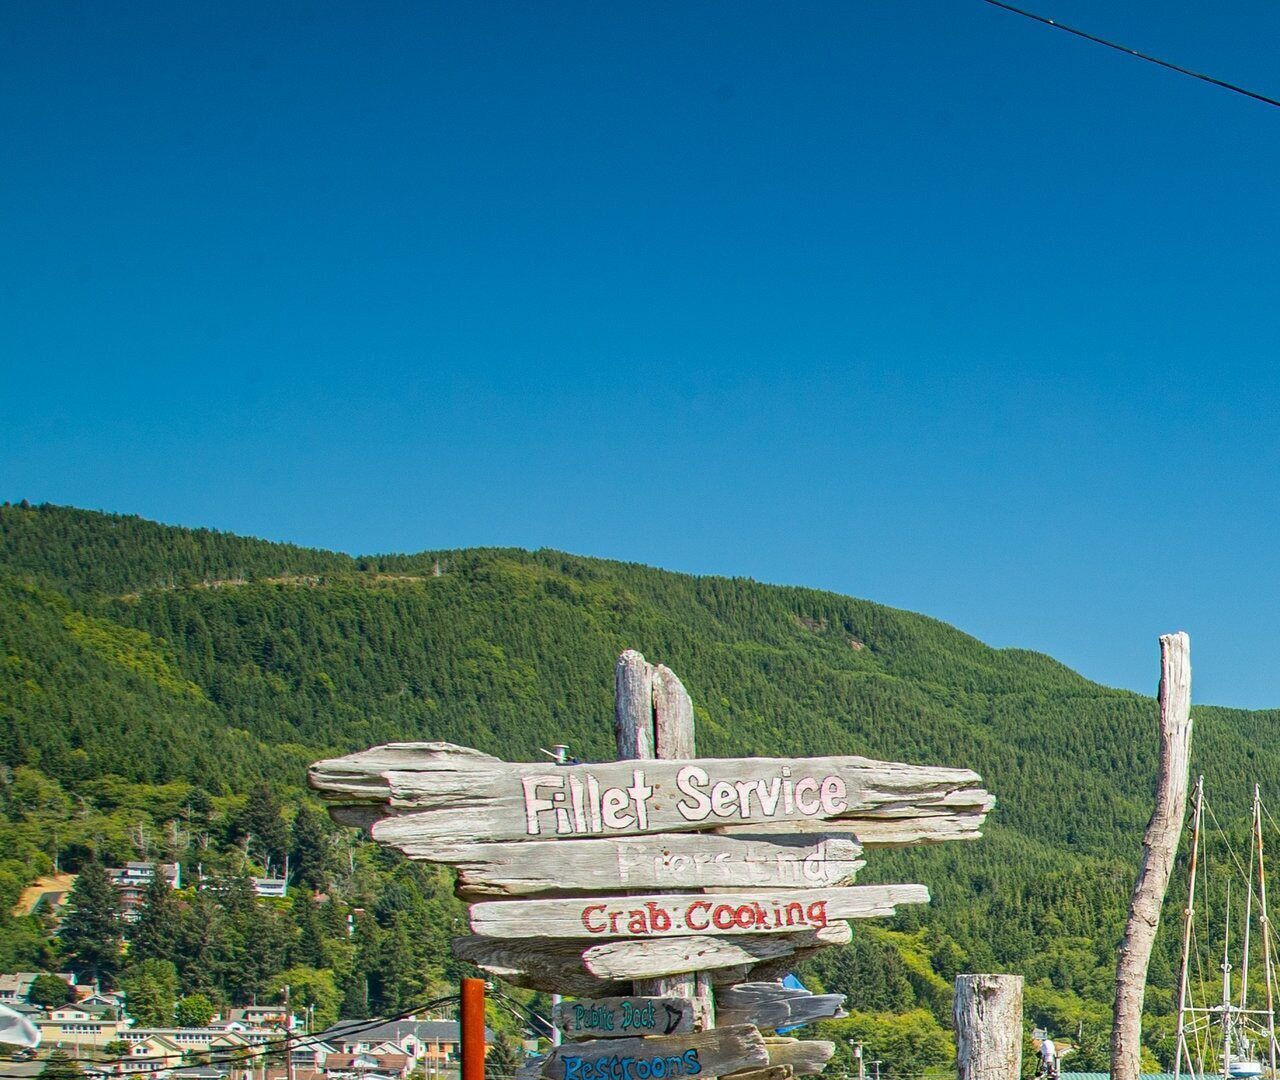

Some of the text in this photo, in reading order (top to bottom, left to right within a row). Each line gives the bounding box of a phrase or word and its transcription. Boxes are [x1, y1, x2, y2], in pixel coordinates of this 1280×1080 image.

[522, 765, 848, 834] Fillet Service
[582, 900, 828, 934] Crab Cooking
[573, 1000, 656, 1031] Public Dock
